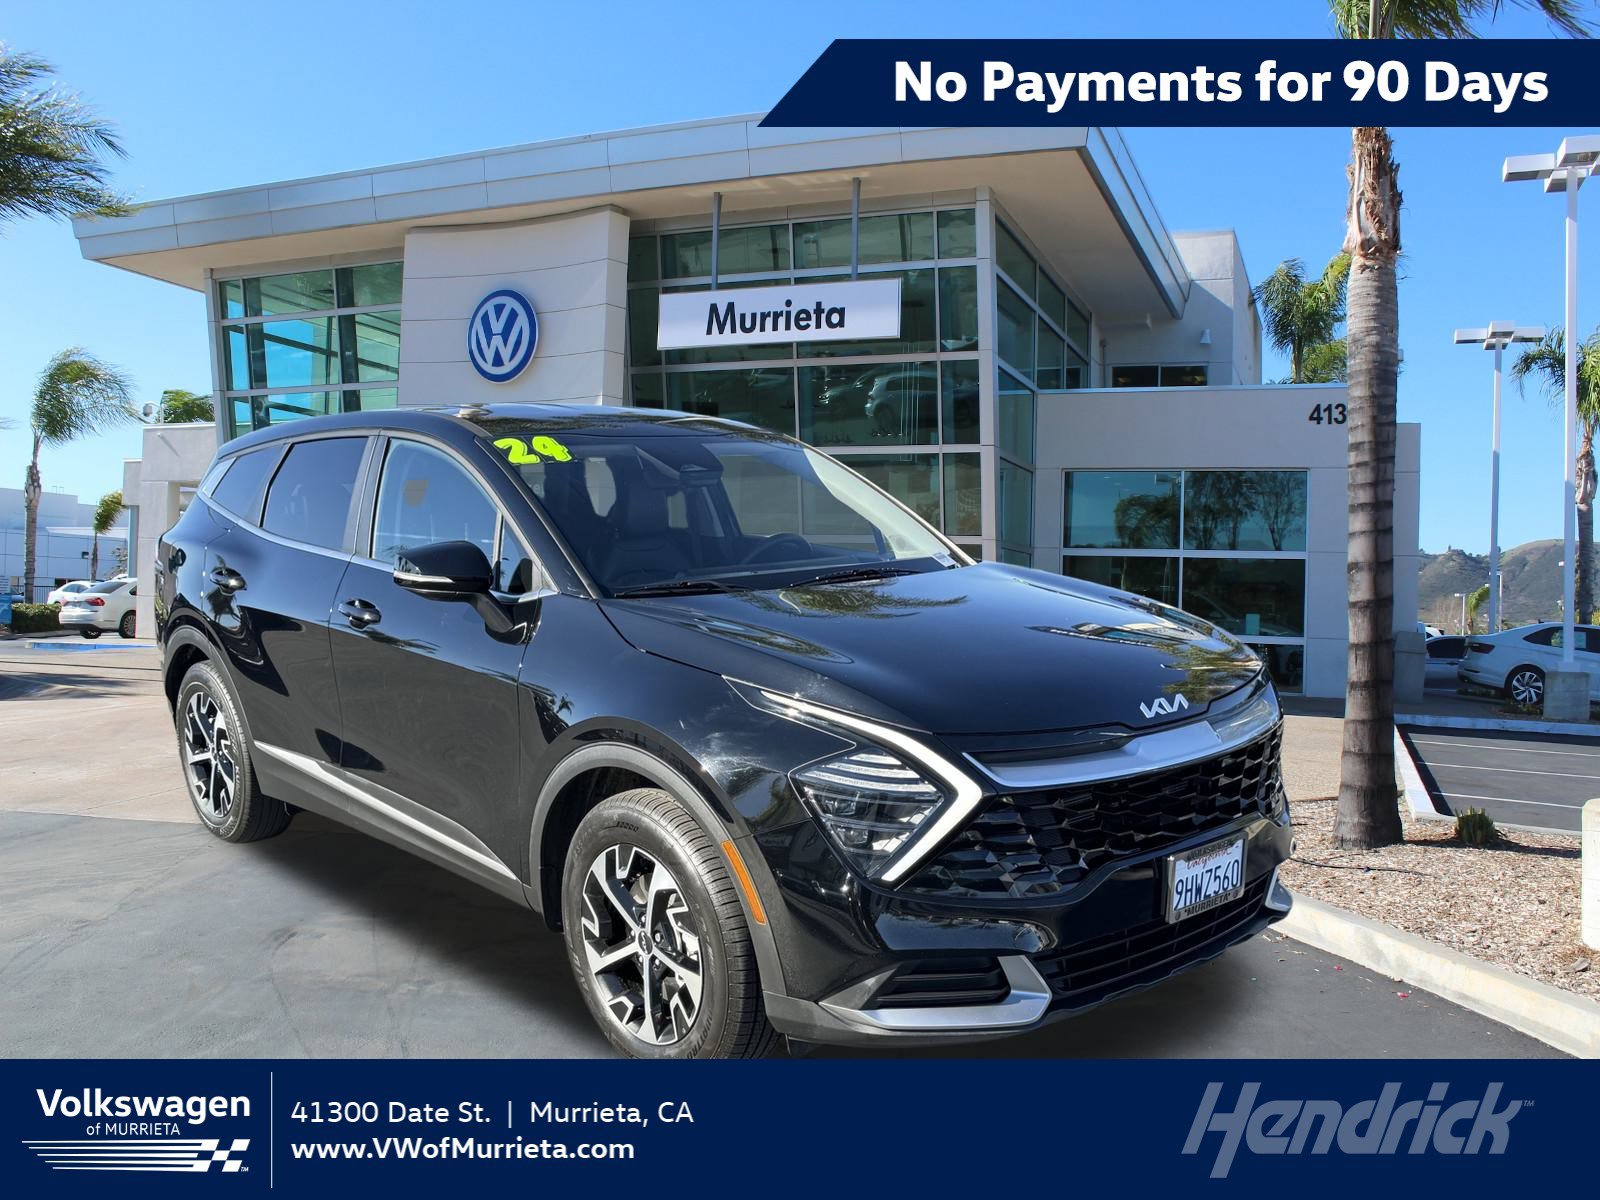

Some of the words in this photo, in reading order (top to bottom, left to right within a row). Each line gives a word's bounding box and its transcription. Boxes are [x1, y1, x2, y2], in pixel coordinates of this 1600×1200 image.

[705, 298, 847, 336] Murrieta
[493, 436, 572, 464] 24
[1139, 693, 1189, 719] KIA
[1174, 859, 1240, 911] 9HWZ560
